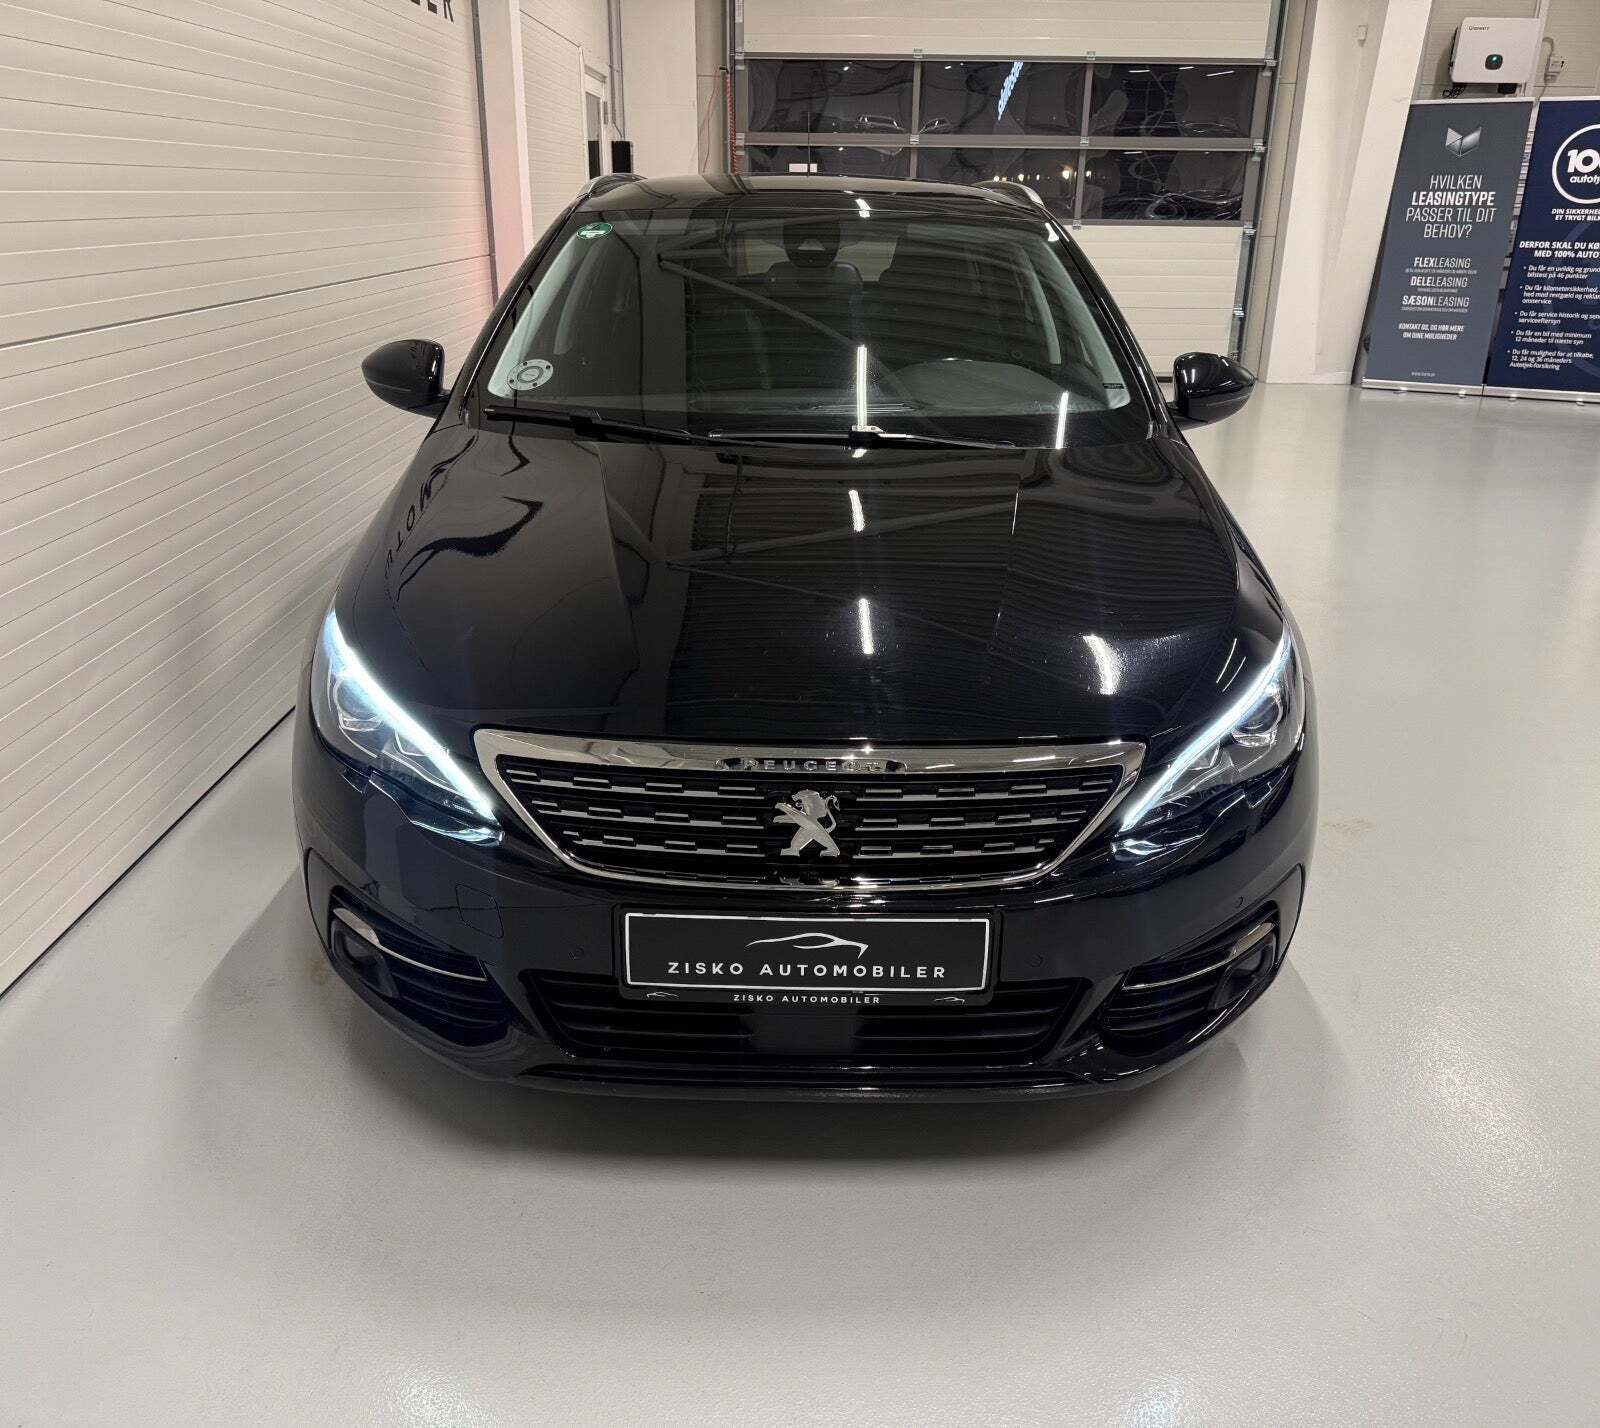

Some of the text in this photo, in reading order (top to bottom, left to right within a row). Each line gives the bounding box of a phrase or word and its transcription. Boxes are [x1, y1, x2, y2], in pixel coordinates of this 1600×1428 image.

[1567, 149, 1600, 173] 10
[1430, 174, 1483, 190] HVILKEN
[1569, 175, 1600, 185] autotj
[1411, 191, 1496, 206] LEASINGTYPE
[1405, 207, 1498, 223] PASSER TIL DIT
[1423, 223, 1473, 239] BEHOV?
[1519, 241, 1600, 250] DERFOR SKAL DU KØ
[1534, 250, 1600, 259] MED 100% AUTO
[1413, 257, 1471, 269] FLEXLEASING
[1410, 276, 1468, 288] DELELEASING
[1402, 295, 1470, 308] SÆSONLEASING
[667, 961, 946, 979] ZISKO AUTOMOBILER
[733, 993, 880, 1004] ZISKO AUTOMOBILER
